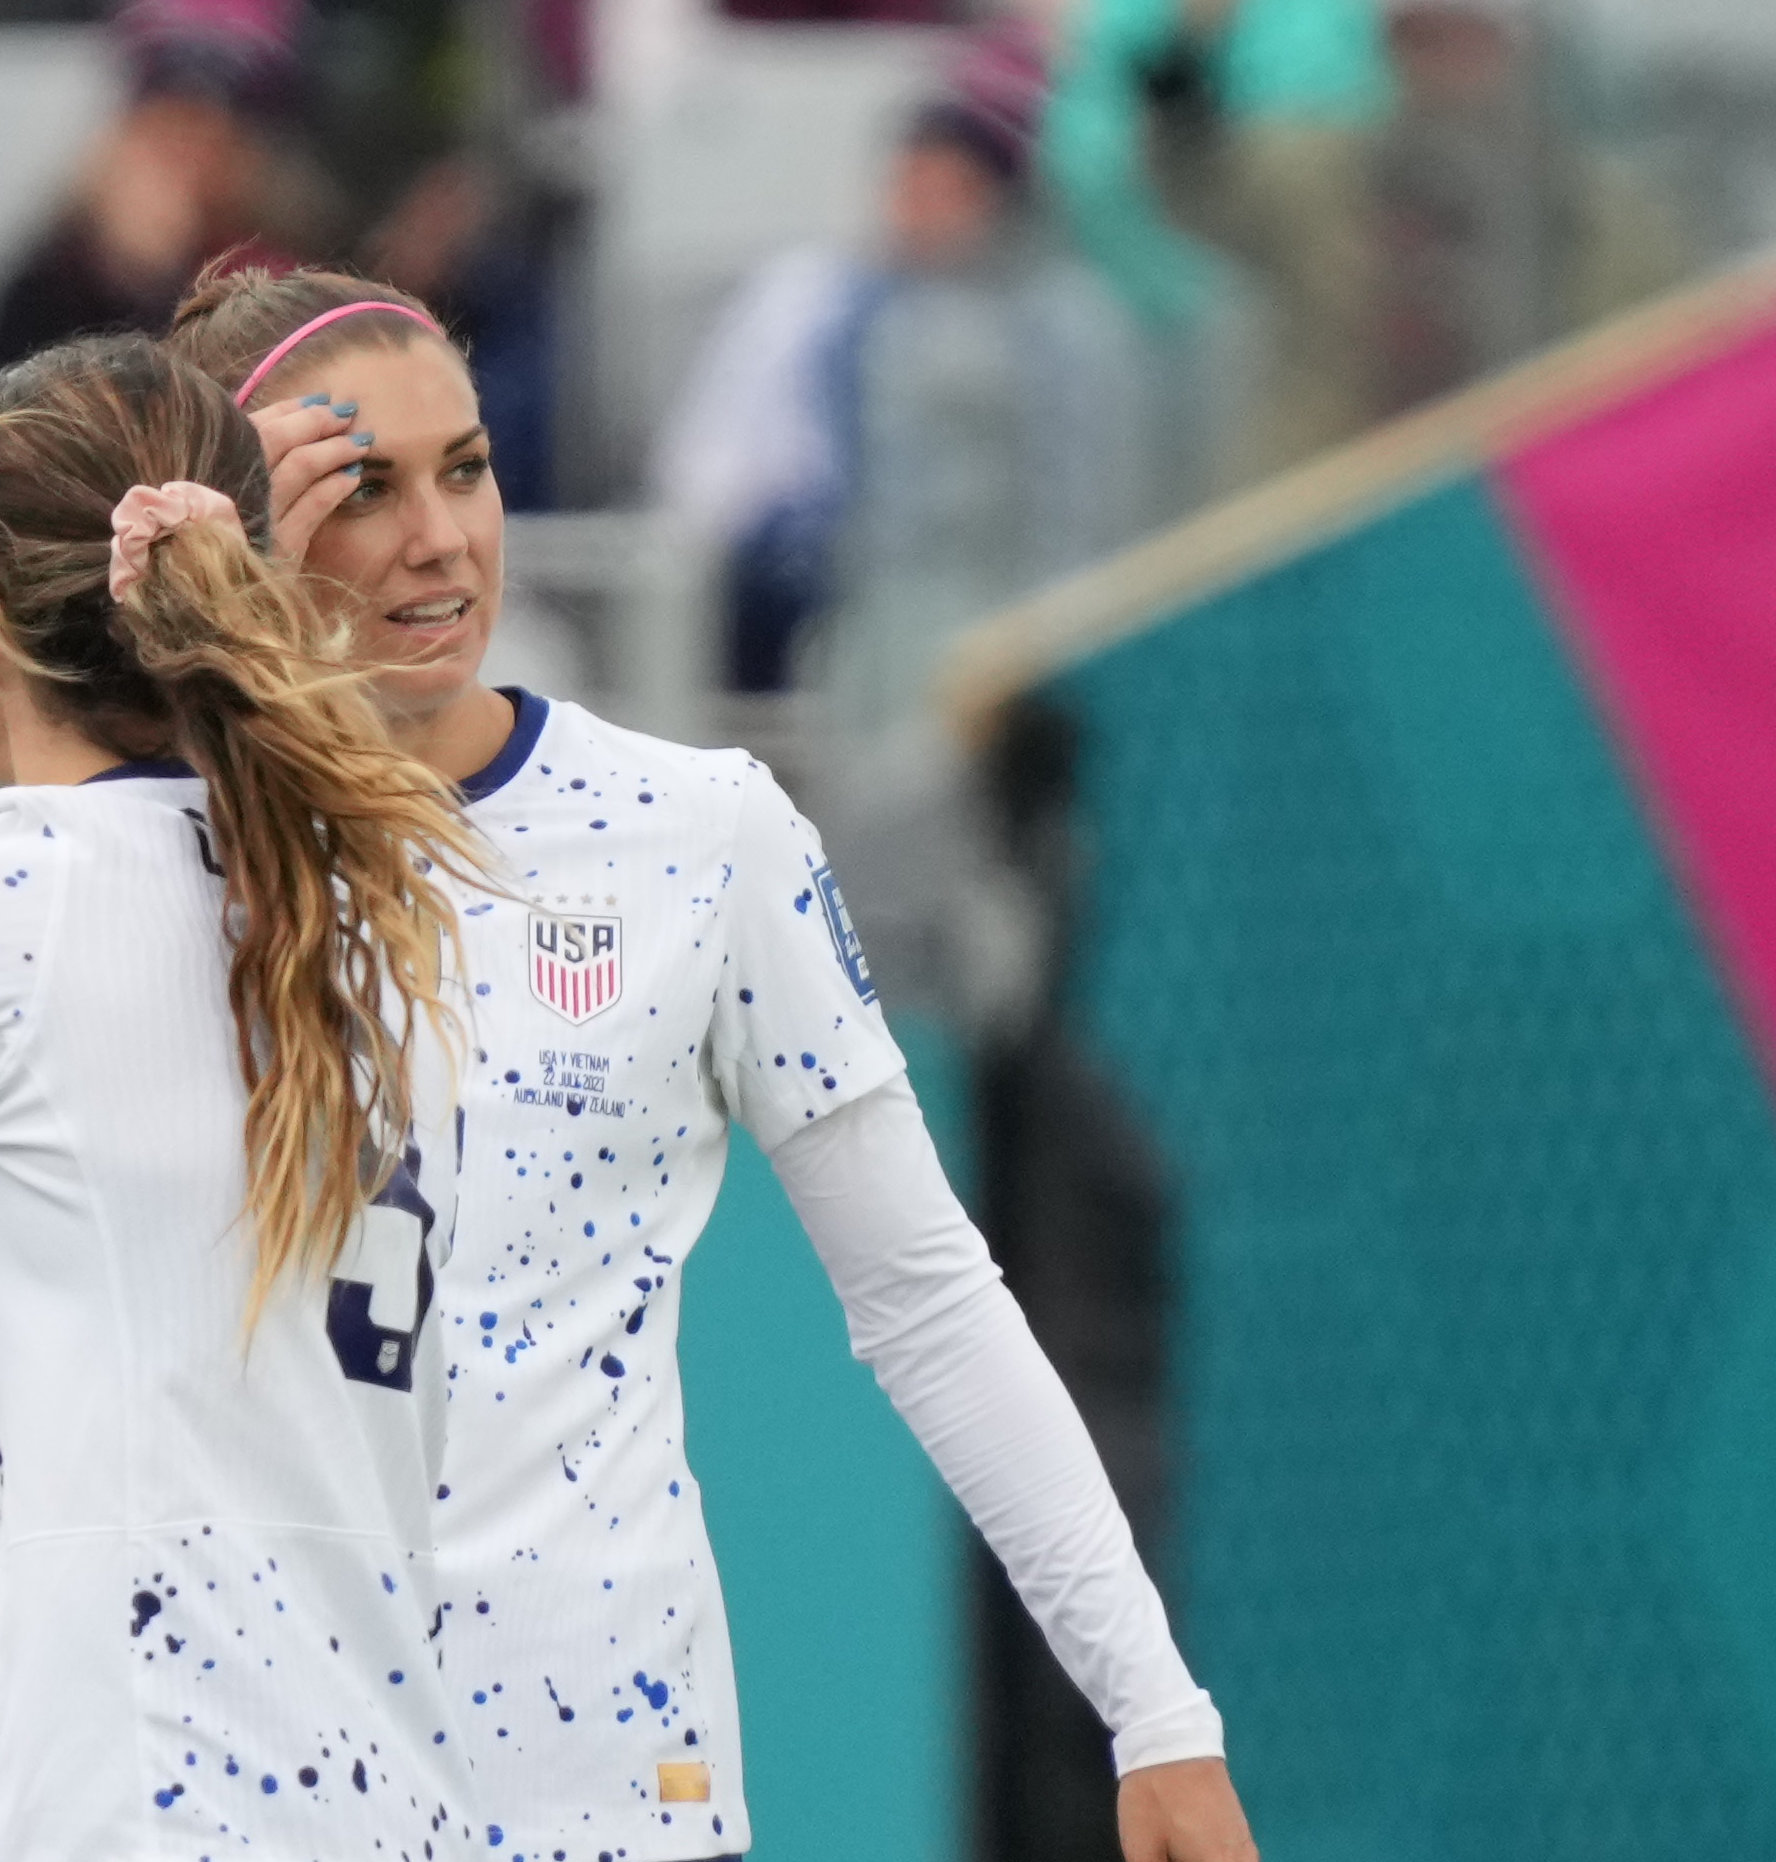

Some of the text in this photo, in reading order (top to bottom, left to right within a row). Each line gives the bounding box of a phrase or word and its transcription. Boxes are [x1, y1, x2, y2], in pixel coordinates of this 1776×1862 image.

[536, 921, 614, 963] USA
[538, 1049, 557, 1067] USA
[570, 1053, 610, 1073] VIETNAM
[559, 1072, 581, 1089] JULY
[583, 1074, 605, 1093] 2023
[514, 1088, 564, 1107] AUCKLAND
[589, 1096, 626, 1118] ZEALAND
